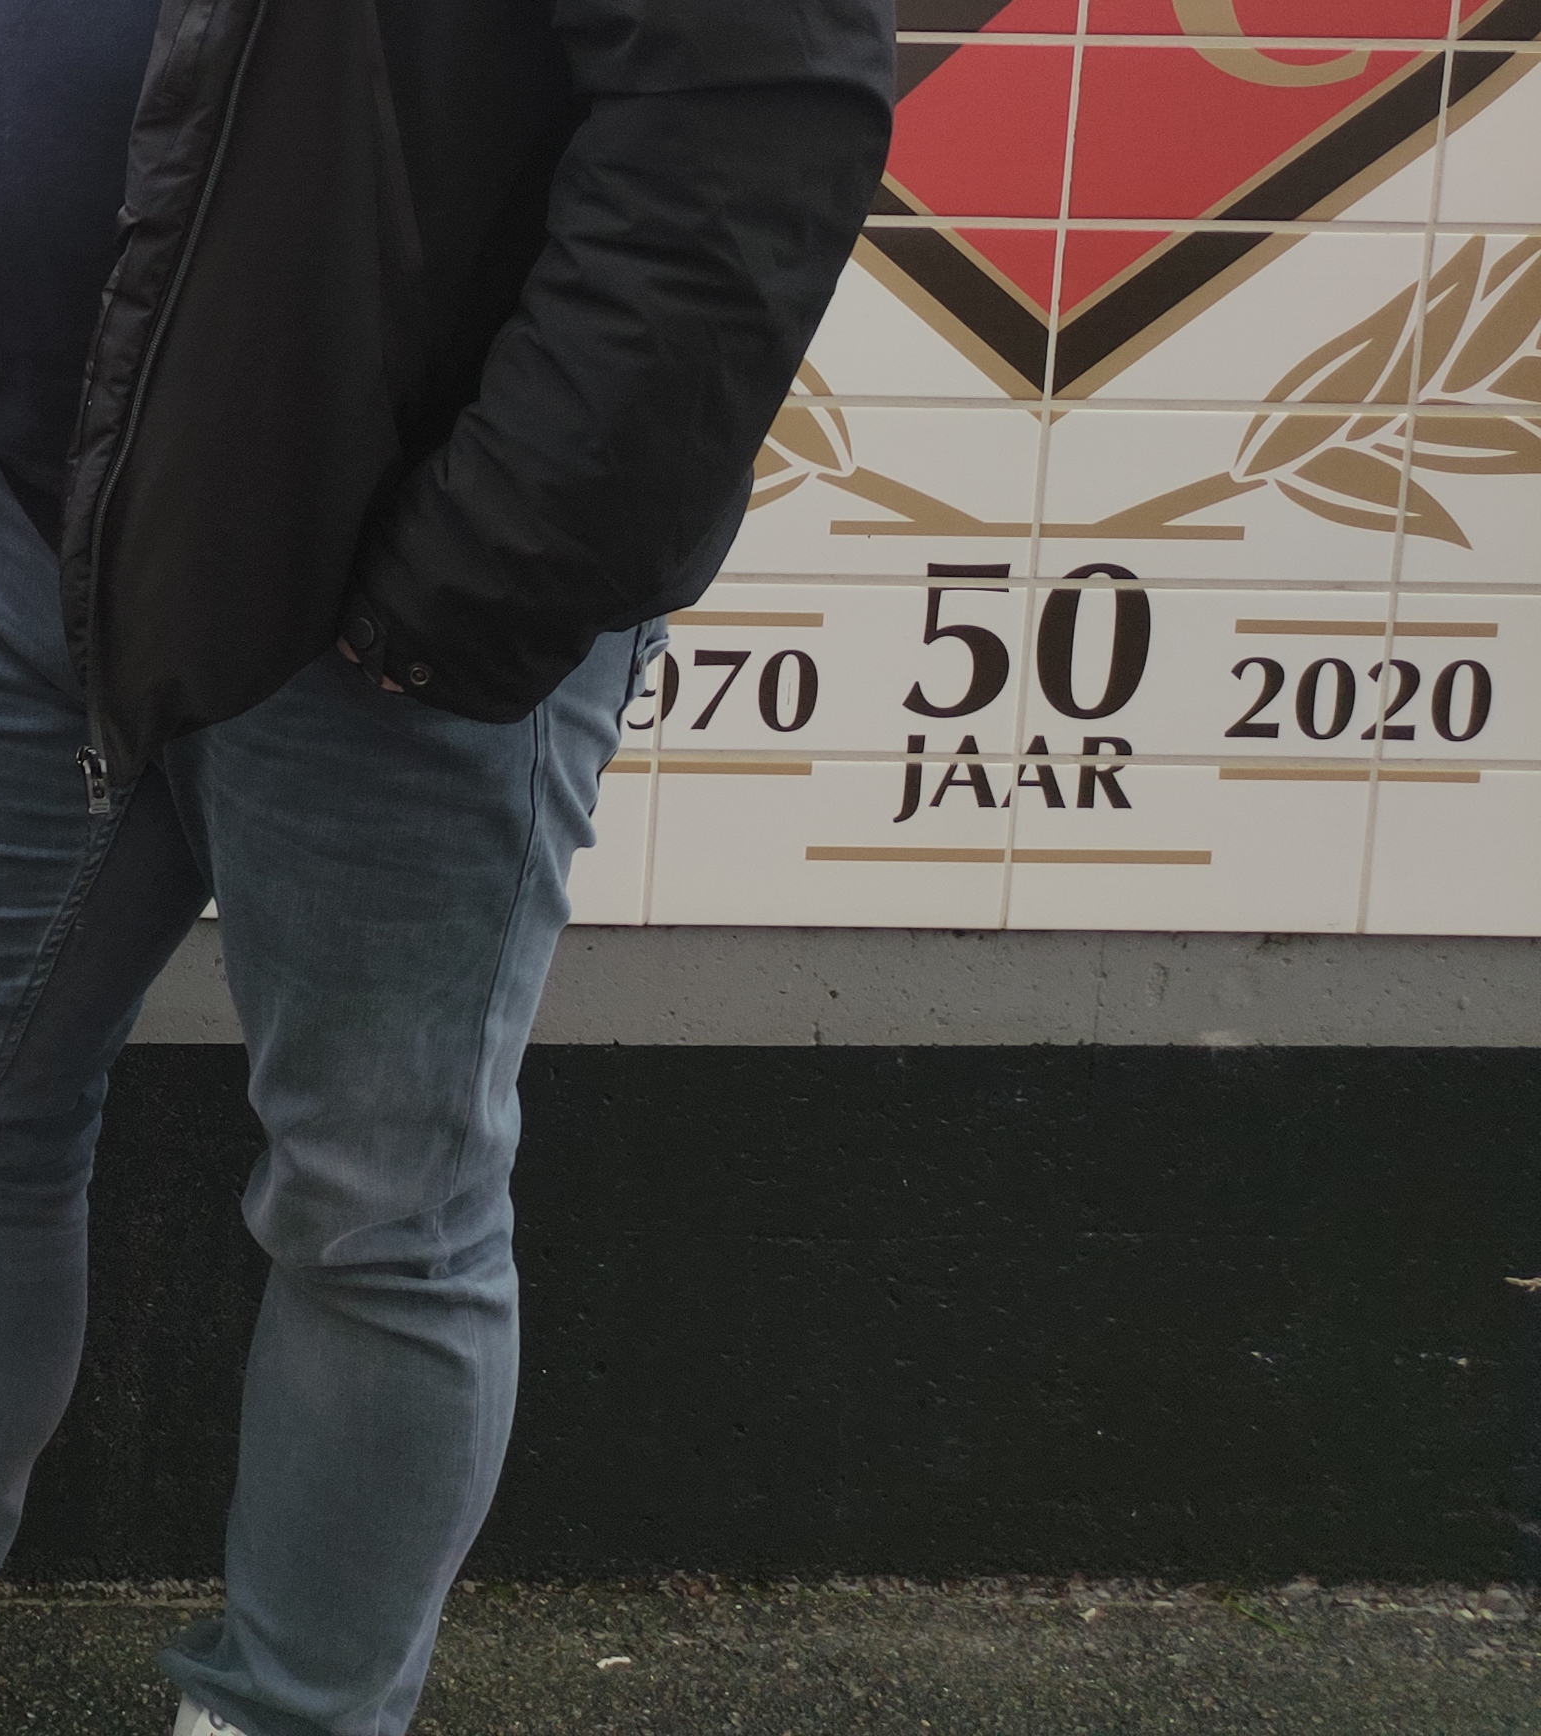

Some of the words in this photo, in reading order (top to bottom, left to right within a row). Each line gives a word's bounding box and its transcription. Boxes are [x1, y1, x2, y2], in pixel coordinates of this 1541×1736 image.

[902, 562, 1152, 720] 50
[626, 649, 819, 732] 970
[1223, 656, 1495, 743] 2020
[893, 734, 1134, 824] JAAR
